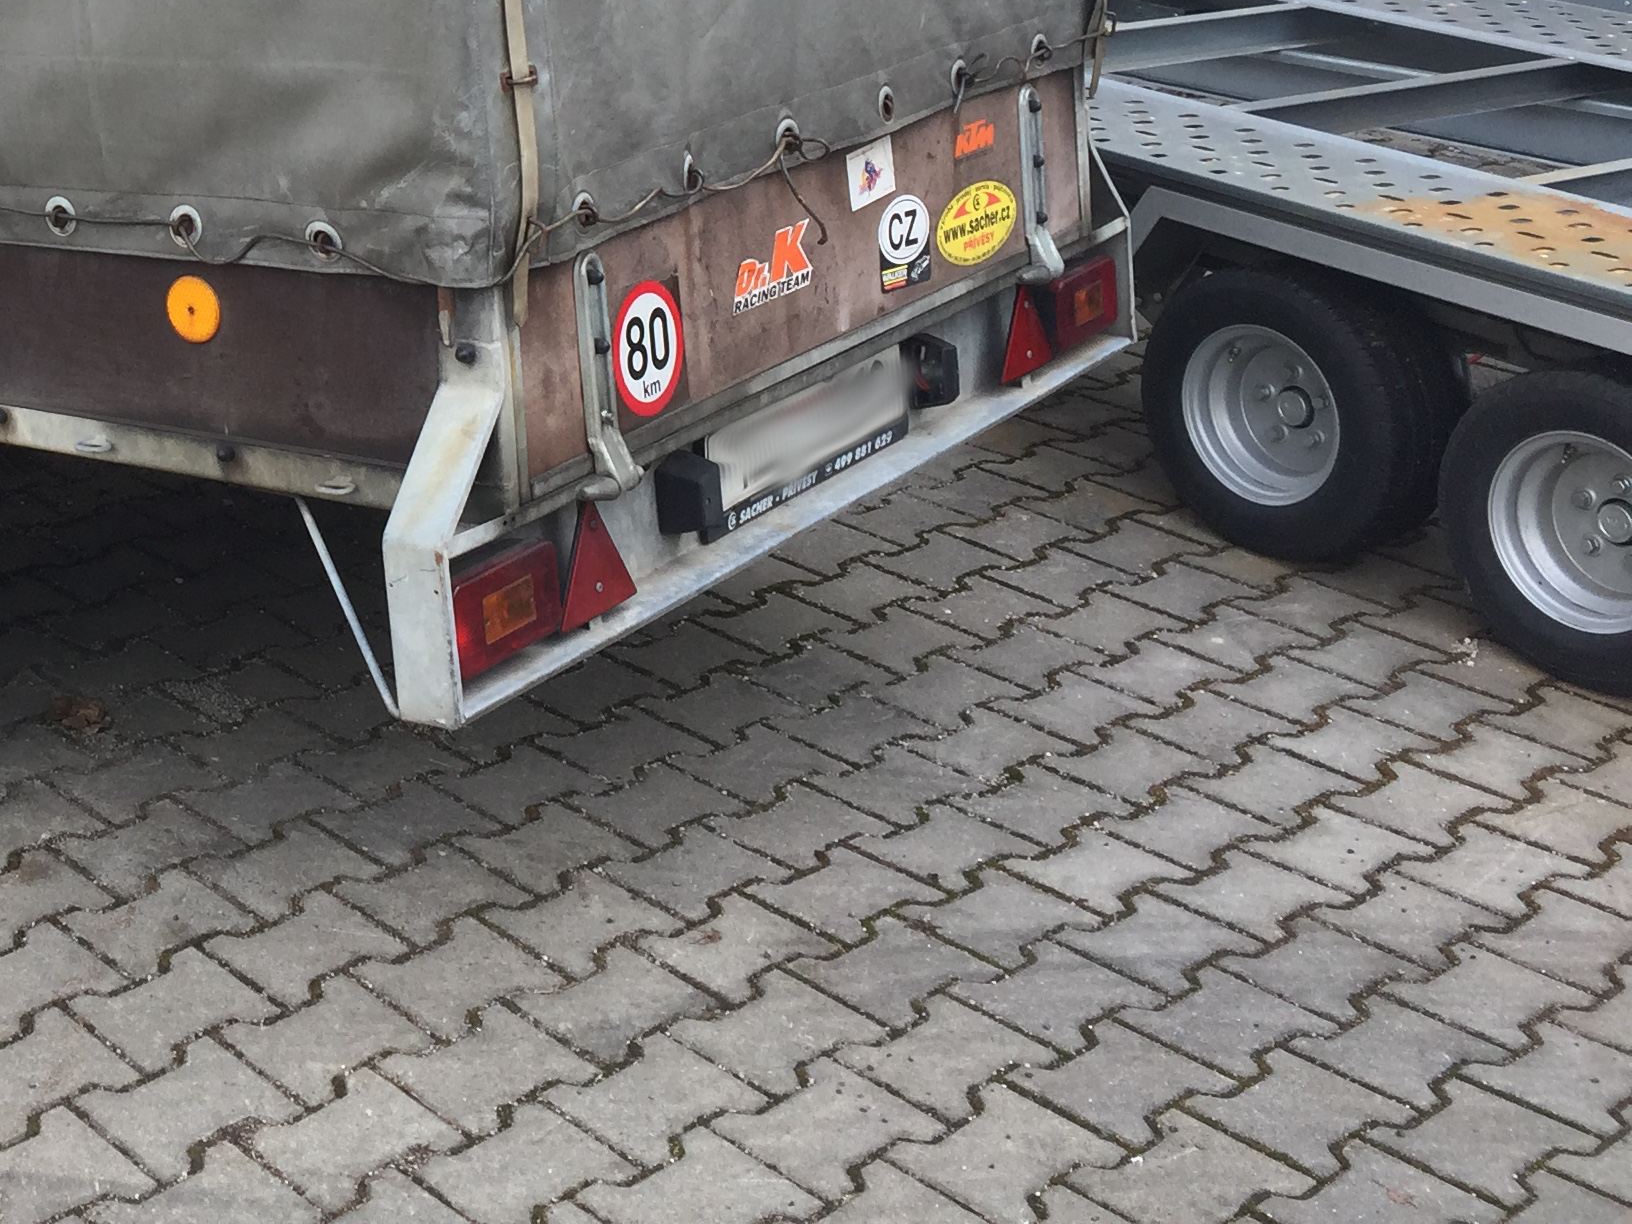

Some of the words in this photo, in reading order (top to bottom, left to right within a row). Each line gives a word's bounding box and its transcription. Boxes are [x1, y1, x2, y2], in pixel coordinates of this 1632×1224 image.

[954, 119, 995, 158] KTM
[888, 208, 918, 251] CZ
[943, 205, 1011, 244] www.sacher.cz
[733, 285, 777, 315] RACING
[780, 271, 810, 294] TEAM
[625, 306, 670, 381] 80
[642, 379, 662, 399] km
[738, 494, 774, 524] SACHER
[854, 440, 872, 461] 881
[874, 430, 893, 450] 629
